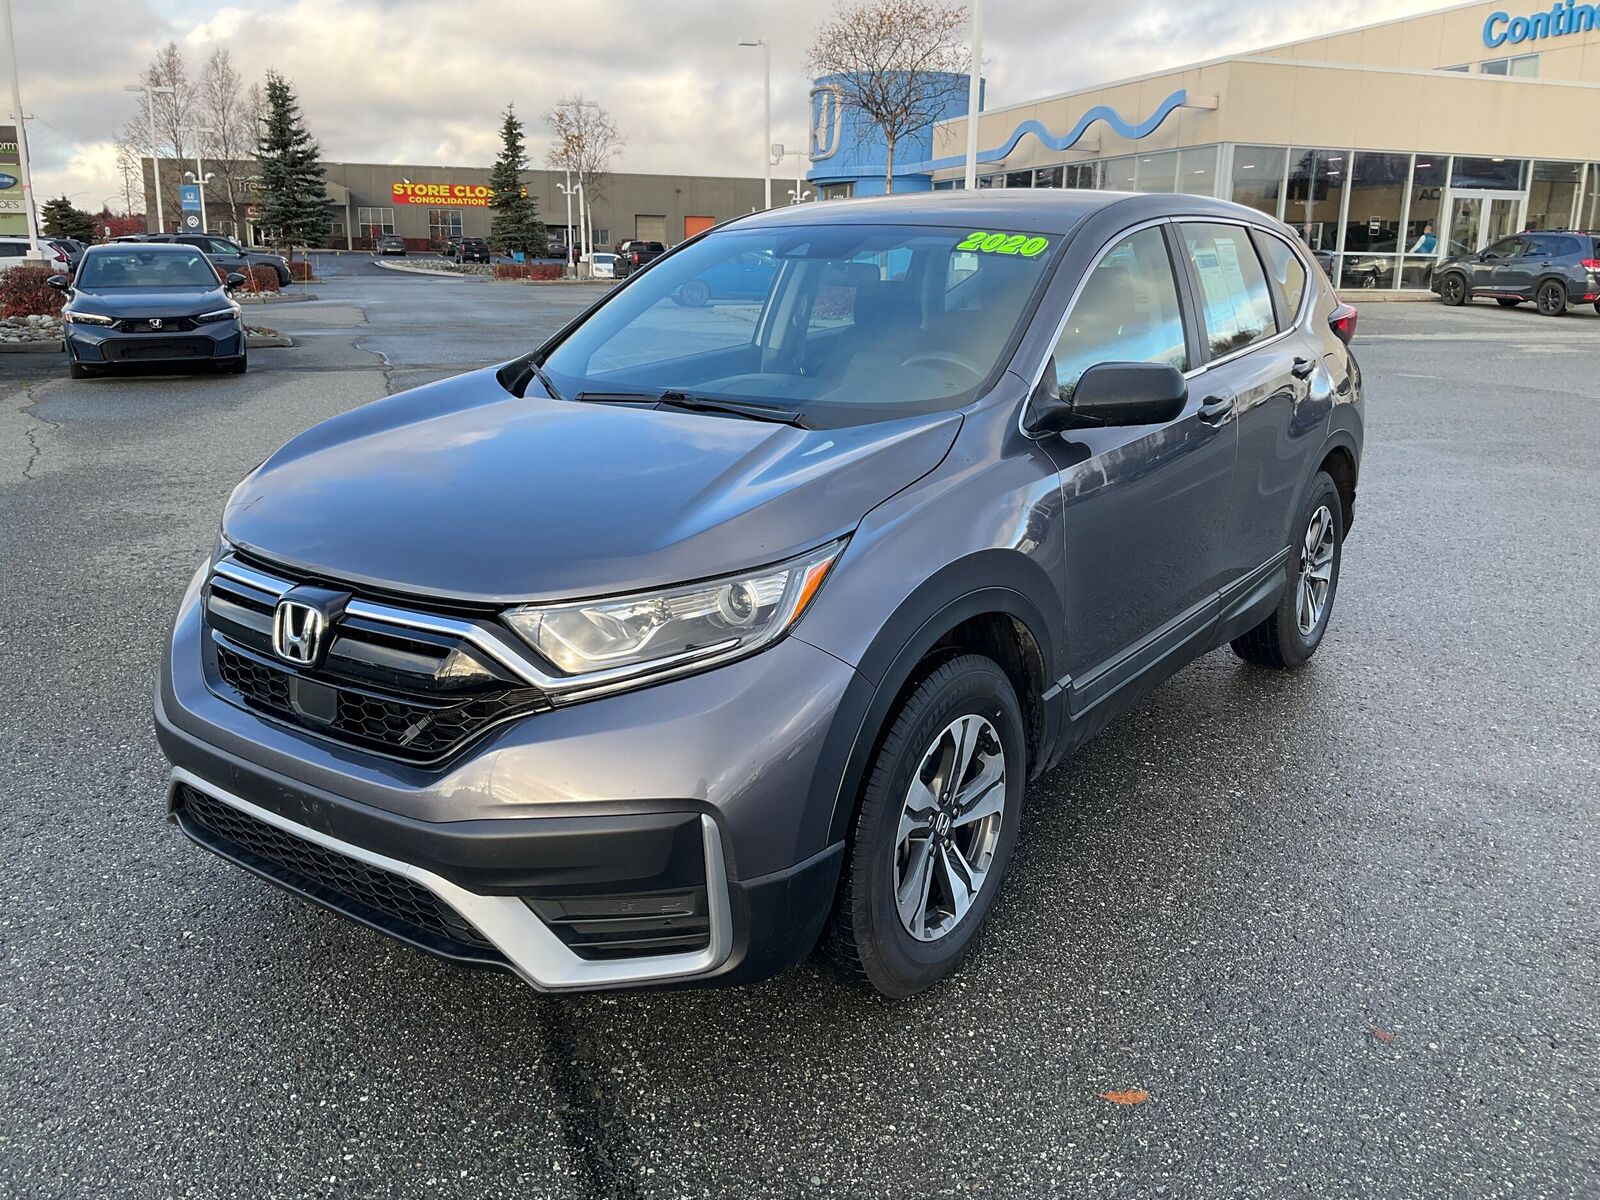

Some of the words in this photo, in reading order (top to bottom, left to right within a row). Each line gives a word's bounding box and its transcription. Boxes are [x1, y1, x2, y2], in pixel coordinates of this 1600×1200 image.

[393, 183, 450, 196] STORE
[408, 196, 485, 205] CONSOLIDATION
[957, 231, 1049, 257] 2020
